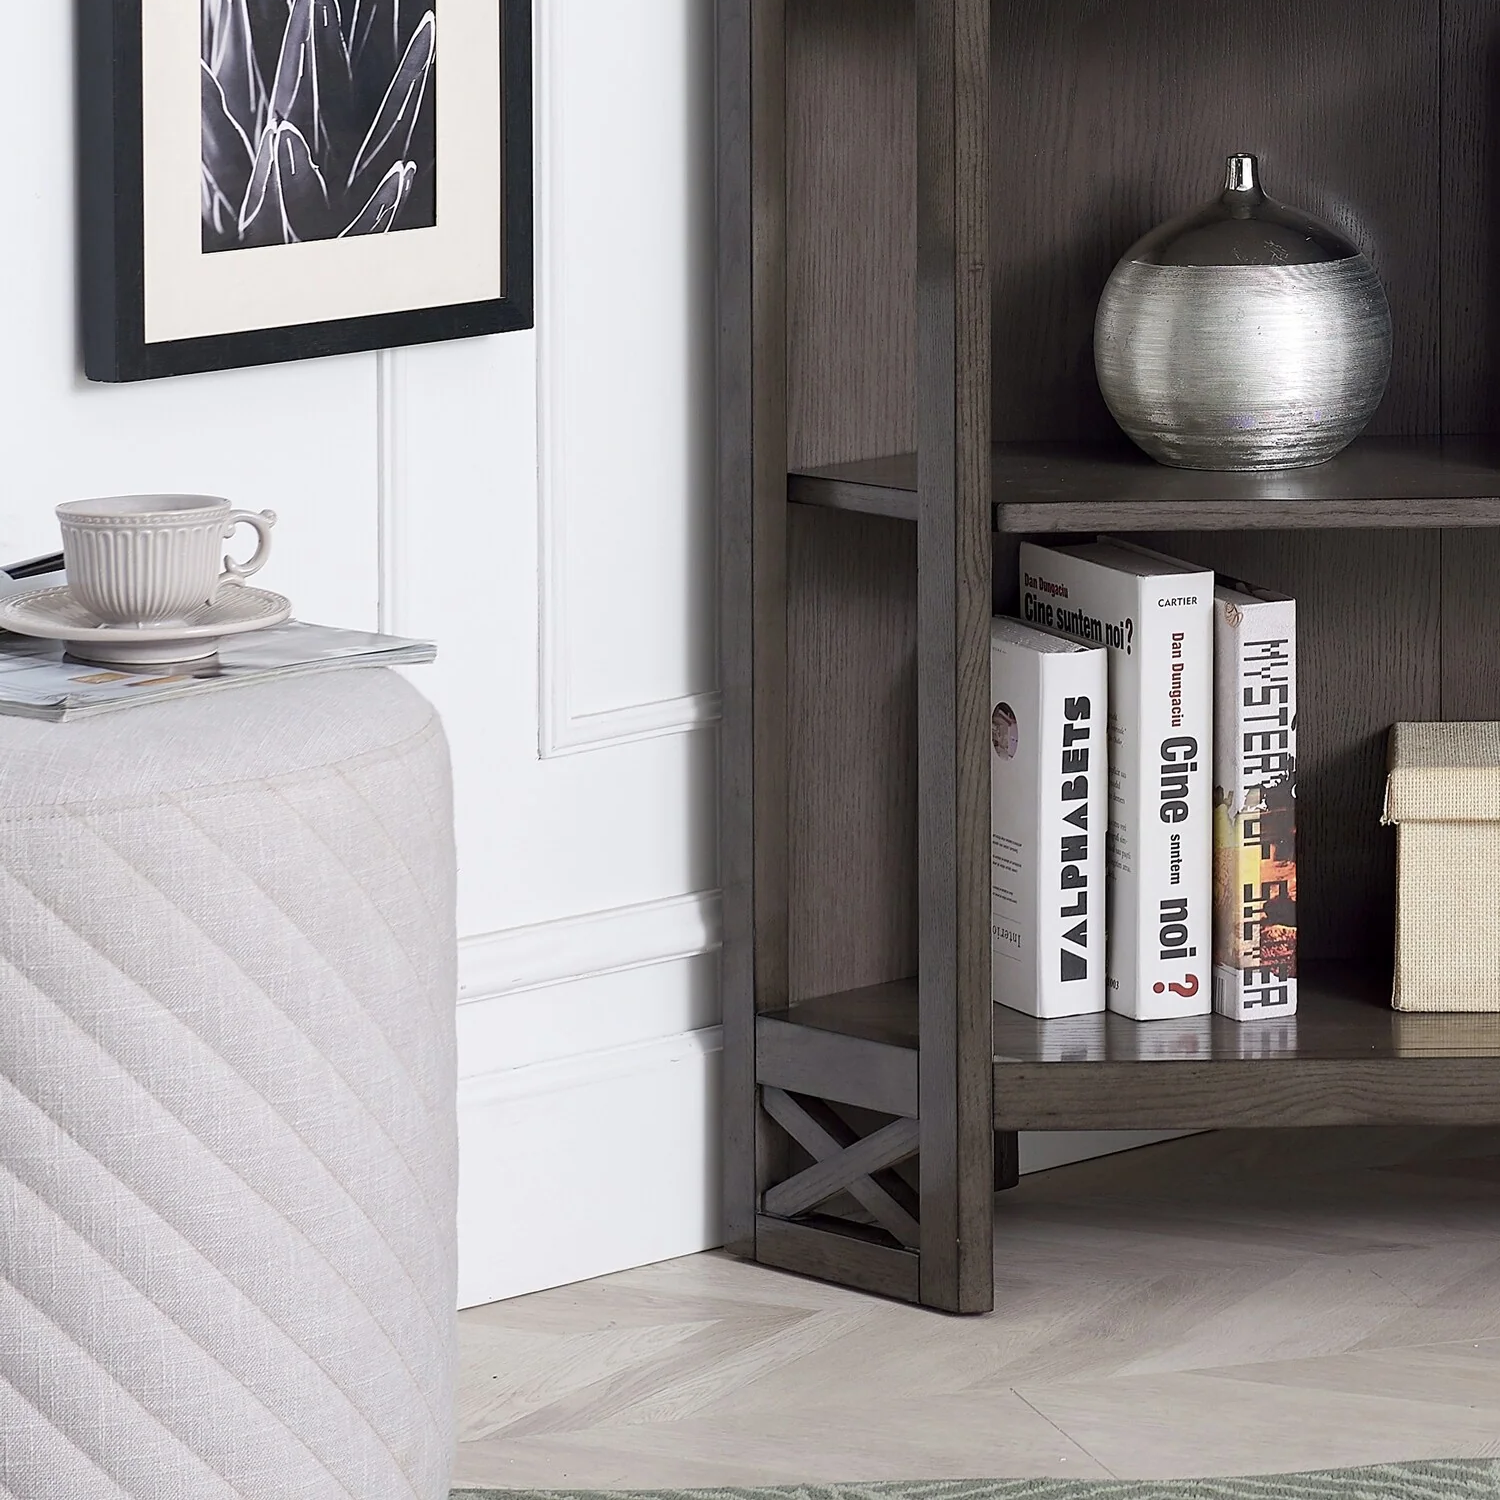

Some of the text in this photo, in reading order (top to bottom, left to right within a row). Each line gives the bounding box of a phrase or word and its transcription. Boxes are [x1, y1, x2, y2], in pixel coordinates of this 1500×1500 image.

[1024, 572, 1069, 599] Dan Dungaciu
[1157, 596, 1198, 607] CARTIER
[1024, 592, 1134, 655] Cine suntem noi?
[1171, 632, 1185, 660] Dan
[1169, 663, 1185, 728] Dungaciu
[1160, 736, 1198, 824] Cine
[1059, 696, 1091, 949] ALPHABETS
[1160, 898, 1197, 960] noi
